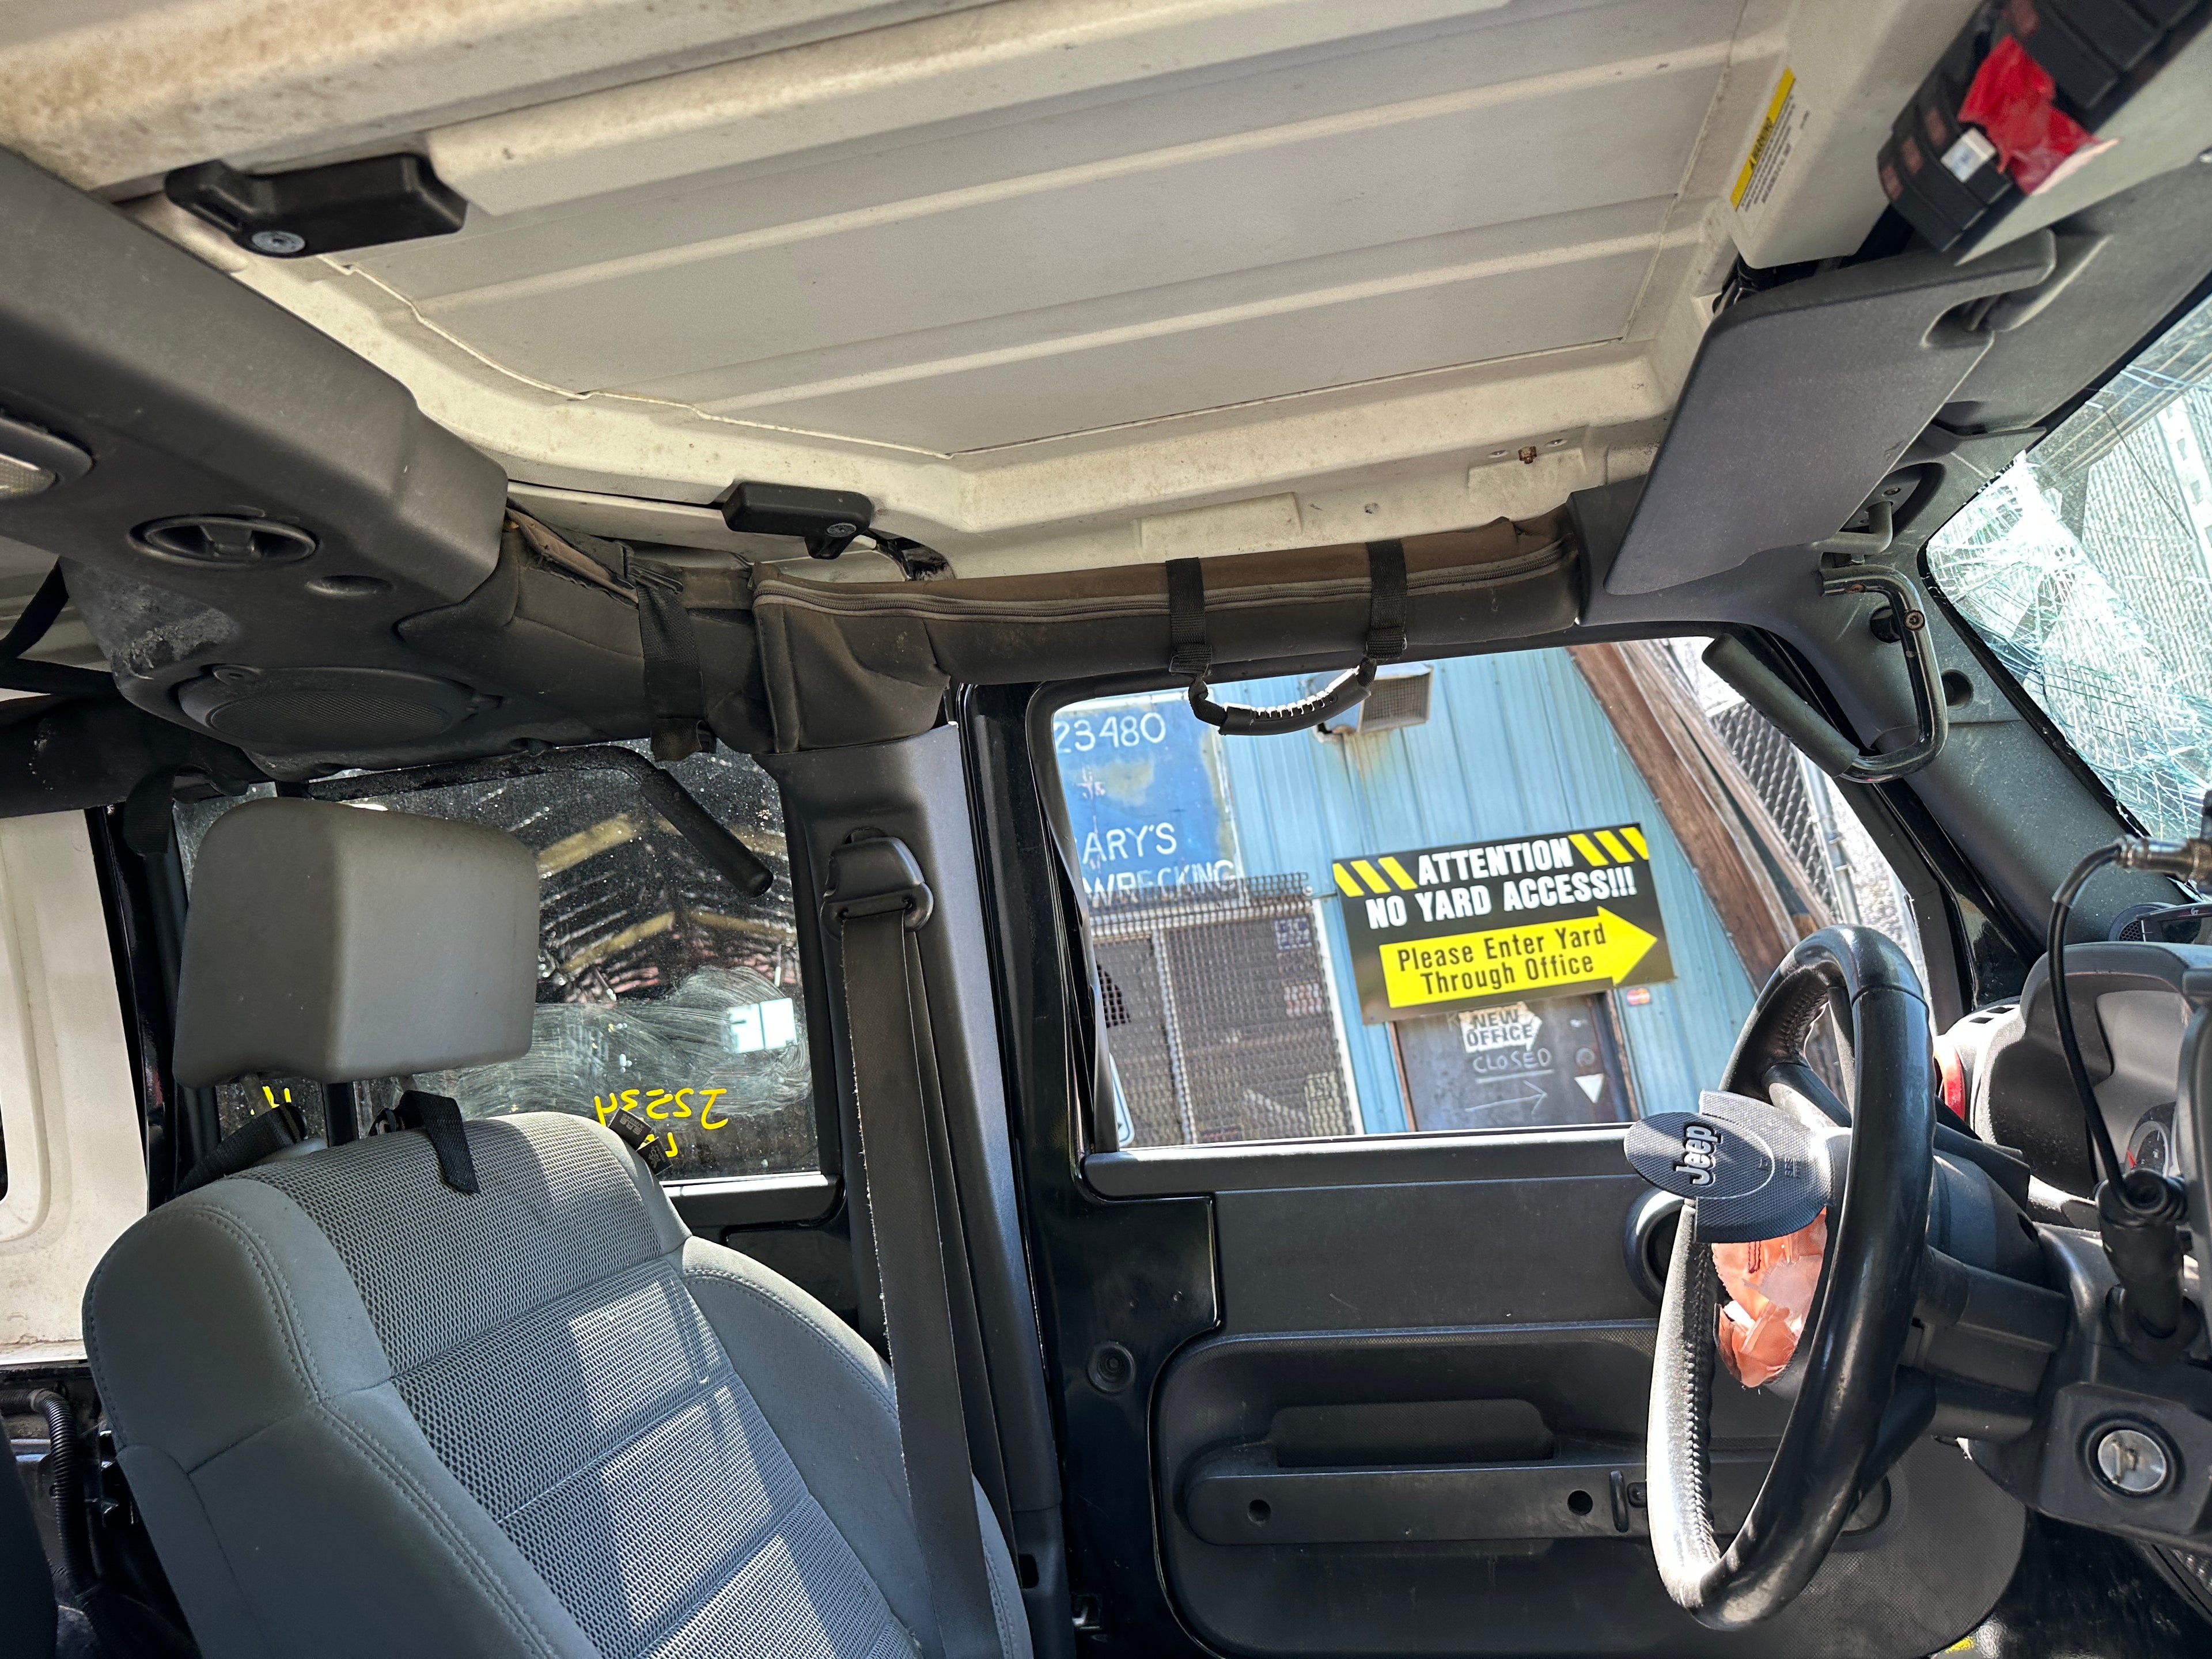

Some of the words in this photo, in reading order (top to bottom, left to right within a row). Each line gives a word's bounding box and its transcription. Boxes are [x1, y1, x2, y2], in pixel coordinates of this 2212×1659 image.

[1054, 712, 1166, 753] 23480
[1074, 822, 1177, 865] ARY'S
[1418, 837, 1574, 886] ATTENTION
[1365, 895, 1407, 929] NO
[1415, 884, 1492, 922] YARD
[1503, 866, 1637, 912] ACCESS!!!
[1397, 945, 1474, 972] Please
[1483, 935, 1544, 960] Enter
[1554, 923, 1607, 950] Yard
[1421, 962, 1516, 995] Through
[1525, 955, 1594, 981] Office
[1467, 1024, 1533, 1047] OFFICE
[1470, 1009, 1519, 1030] NEW
[1472, 1047, 1552, 1074] CLOSED
[1675, 1126, 1719, 1185] Jeep
